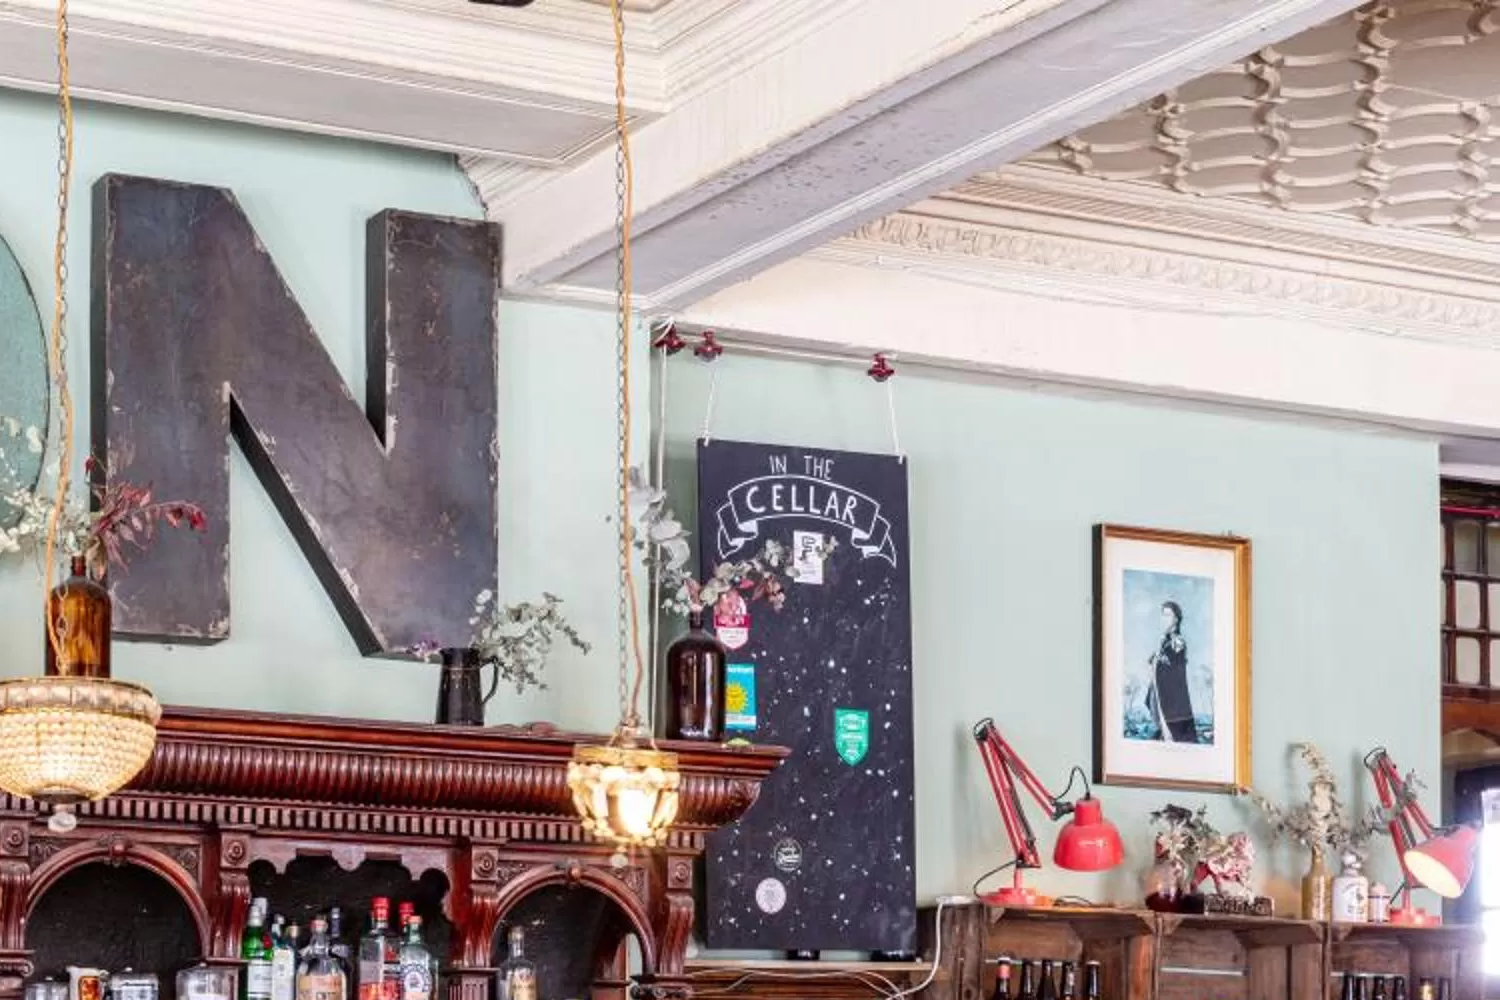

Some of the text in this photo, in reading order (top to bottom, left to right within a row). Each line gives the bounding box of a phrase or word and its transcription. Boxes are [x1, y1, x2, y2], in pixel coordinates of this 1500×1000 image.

[768, 455, 836, 480] IN THE
[745, 483, 858, 526] CELLAR
